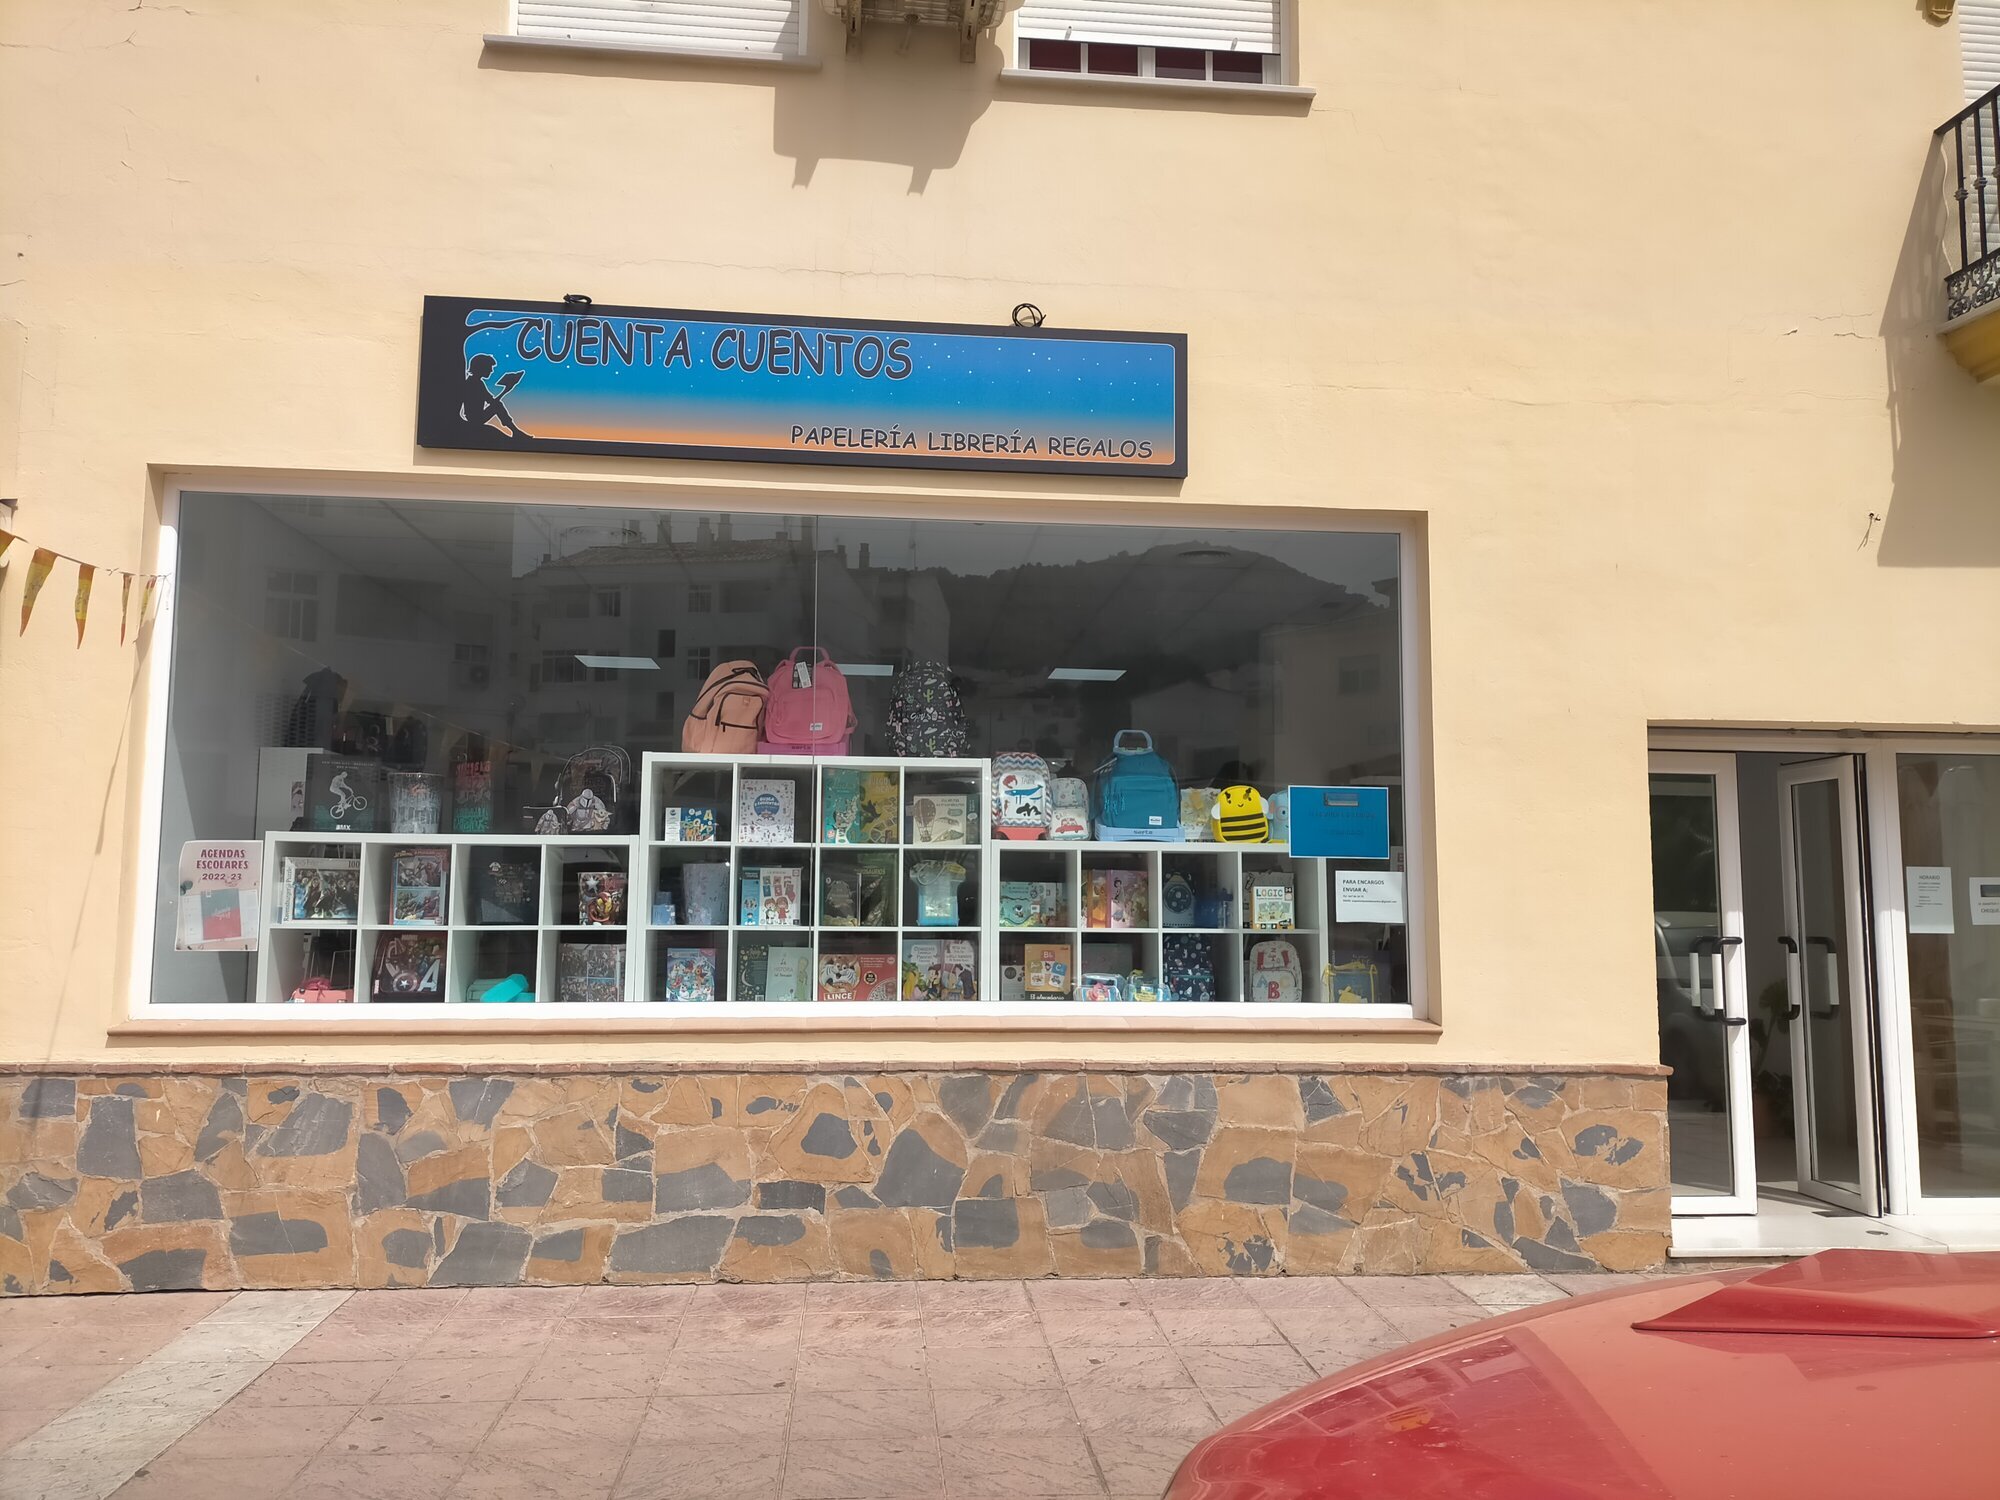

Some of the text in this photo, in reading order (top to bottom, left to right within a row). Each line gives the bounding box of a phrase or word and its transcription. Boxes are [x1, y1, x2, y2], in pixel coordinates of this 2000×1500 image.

[517, 317, 913, 381] CUENTA CUENTOS
[791, 424, 1153, 459] PAPELERÍA LIBRERÍA REGALOS
[200, 848, 246, 858] AGENDAS
[196, 859, 249, 870] ESCOLARES
[1255, 888, 1283, 898] LOGIC
[826, 992, 853, 1000] LINCE
